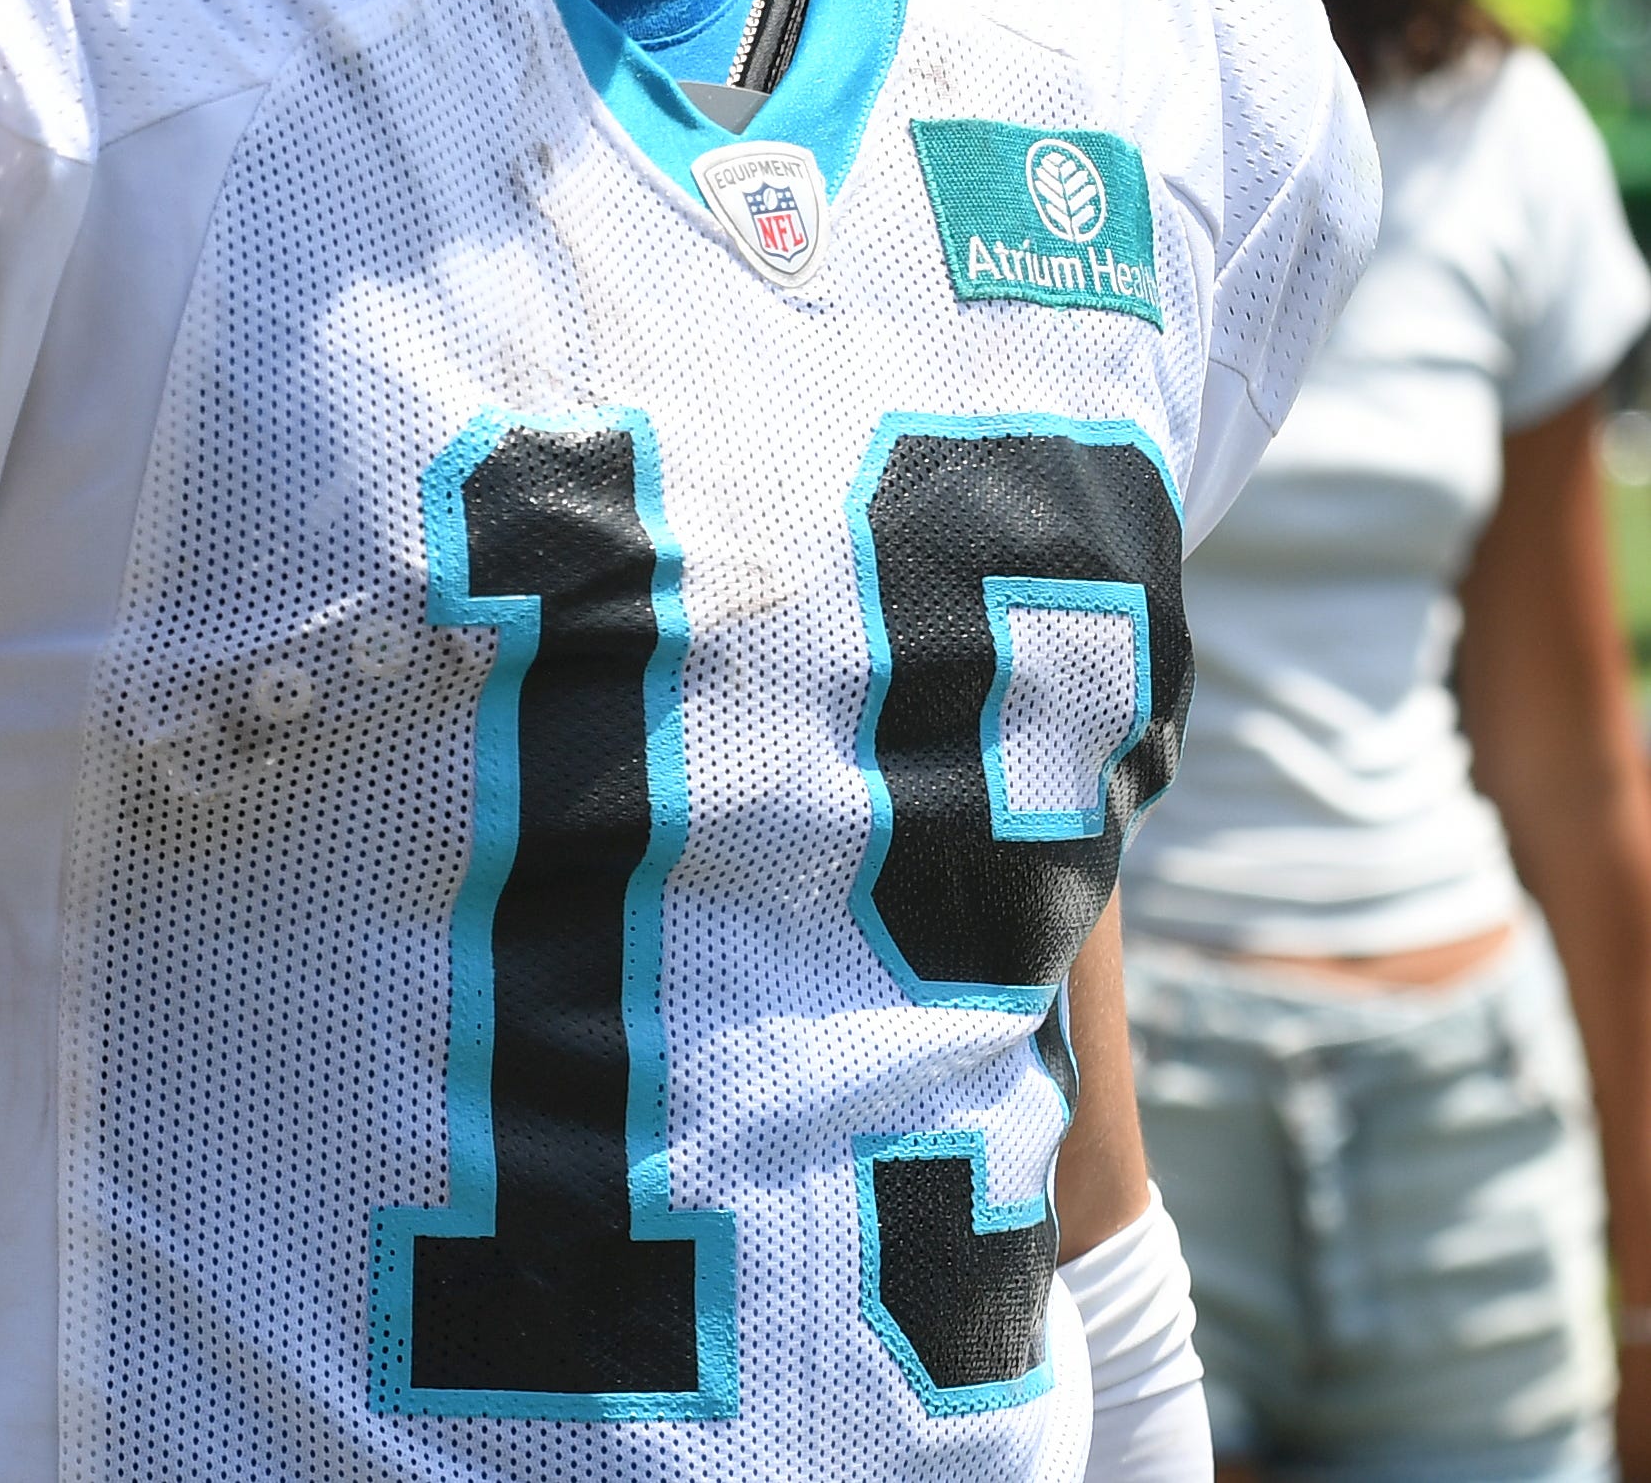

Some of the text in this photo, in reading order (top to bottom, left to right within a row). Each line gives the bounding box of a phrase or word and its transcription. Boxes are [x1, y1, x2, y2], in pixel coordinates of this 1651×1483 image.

[714, 160, 804, 189] EQUIPMENT
[757, 214, 804, 252] NFL
[967, 236, 1086, 289] Atrium
[368, 406, 1197, 1421] 19
